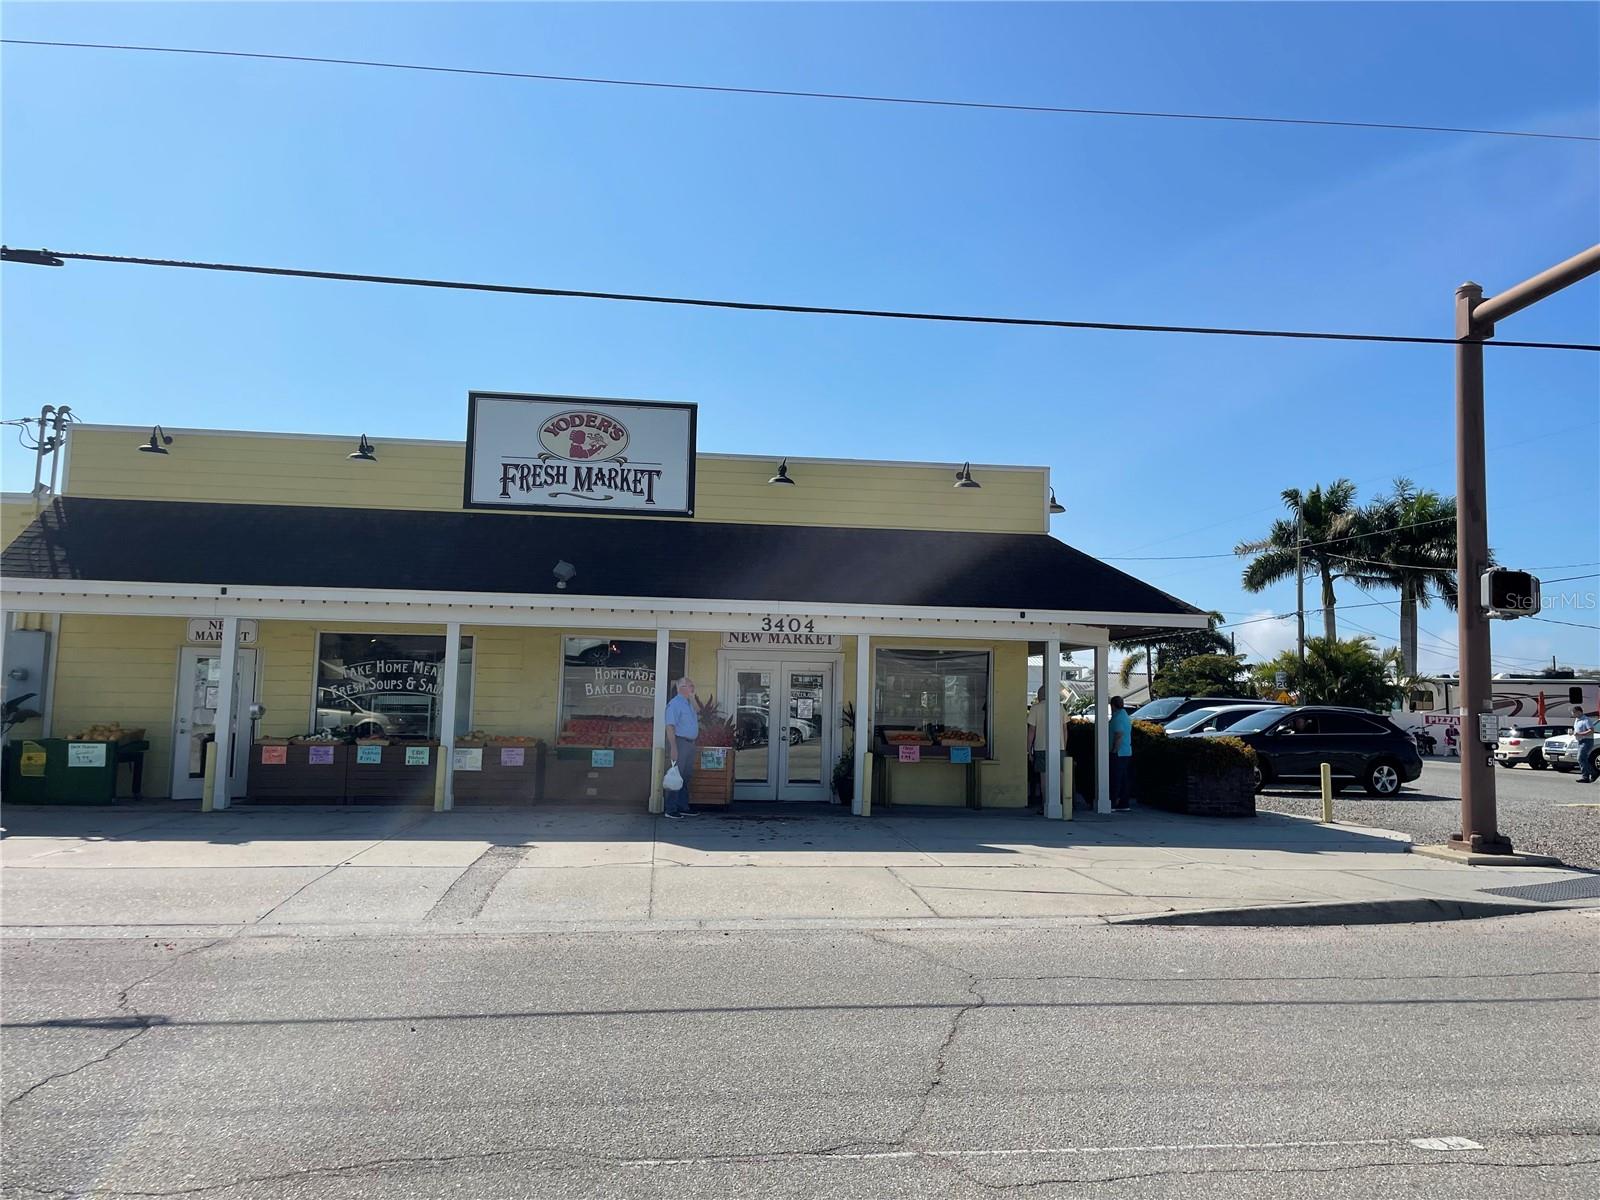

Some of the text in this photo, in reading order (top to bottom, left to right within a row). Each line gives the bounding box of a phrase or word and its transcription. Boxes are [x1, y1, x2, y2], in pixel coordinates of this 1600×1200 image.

[543, 413, 625, 442] YODER'S
[499, 463, 662, 504] FRESH MARKET
[208, 620, 225, 630] NE
[761, 617, 815, 632] 3404
[195, 631, 250, 641] MART
[728, 631, 833, 645] NEW MARKET
[341, 660, 441, 678] TAKE HOME MEA
[594, 667, 655, 682] HOMEMADE
[330, 677, 442, 698] FRESH SOUPS & SAL
[585, 681, 656, 696] BAKED GOOD
[1428, 716, 1460, 725] PIZZA
